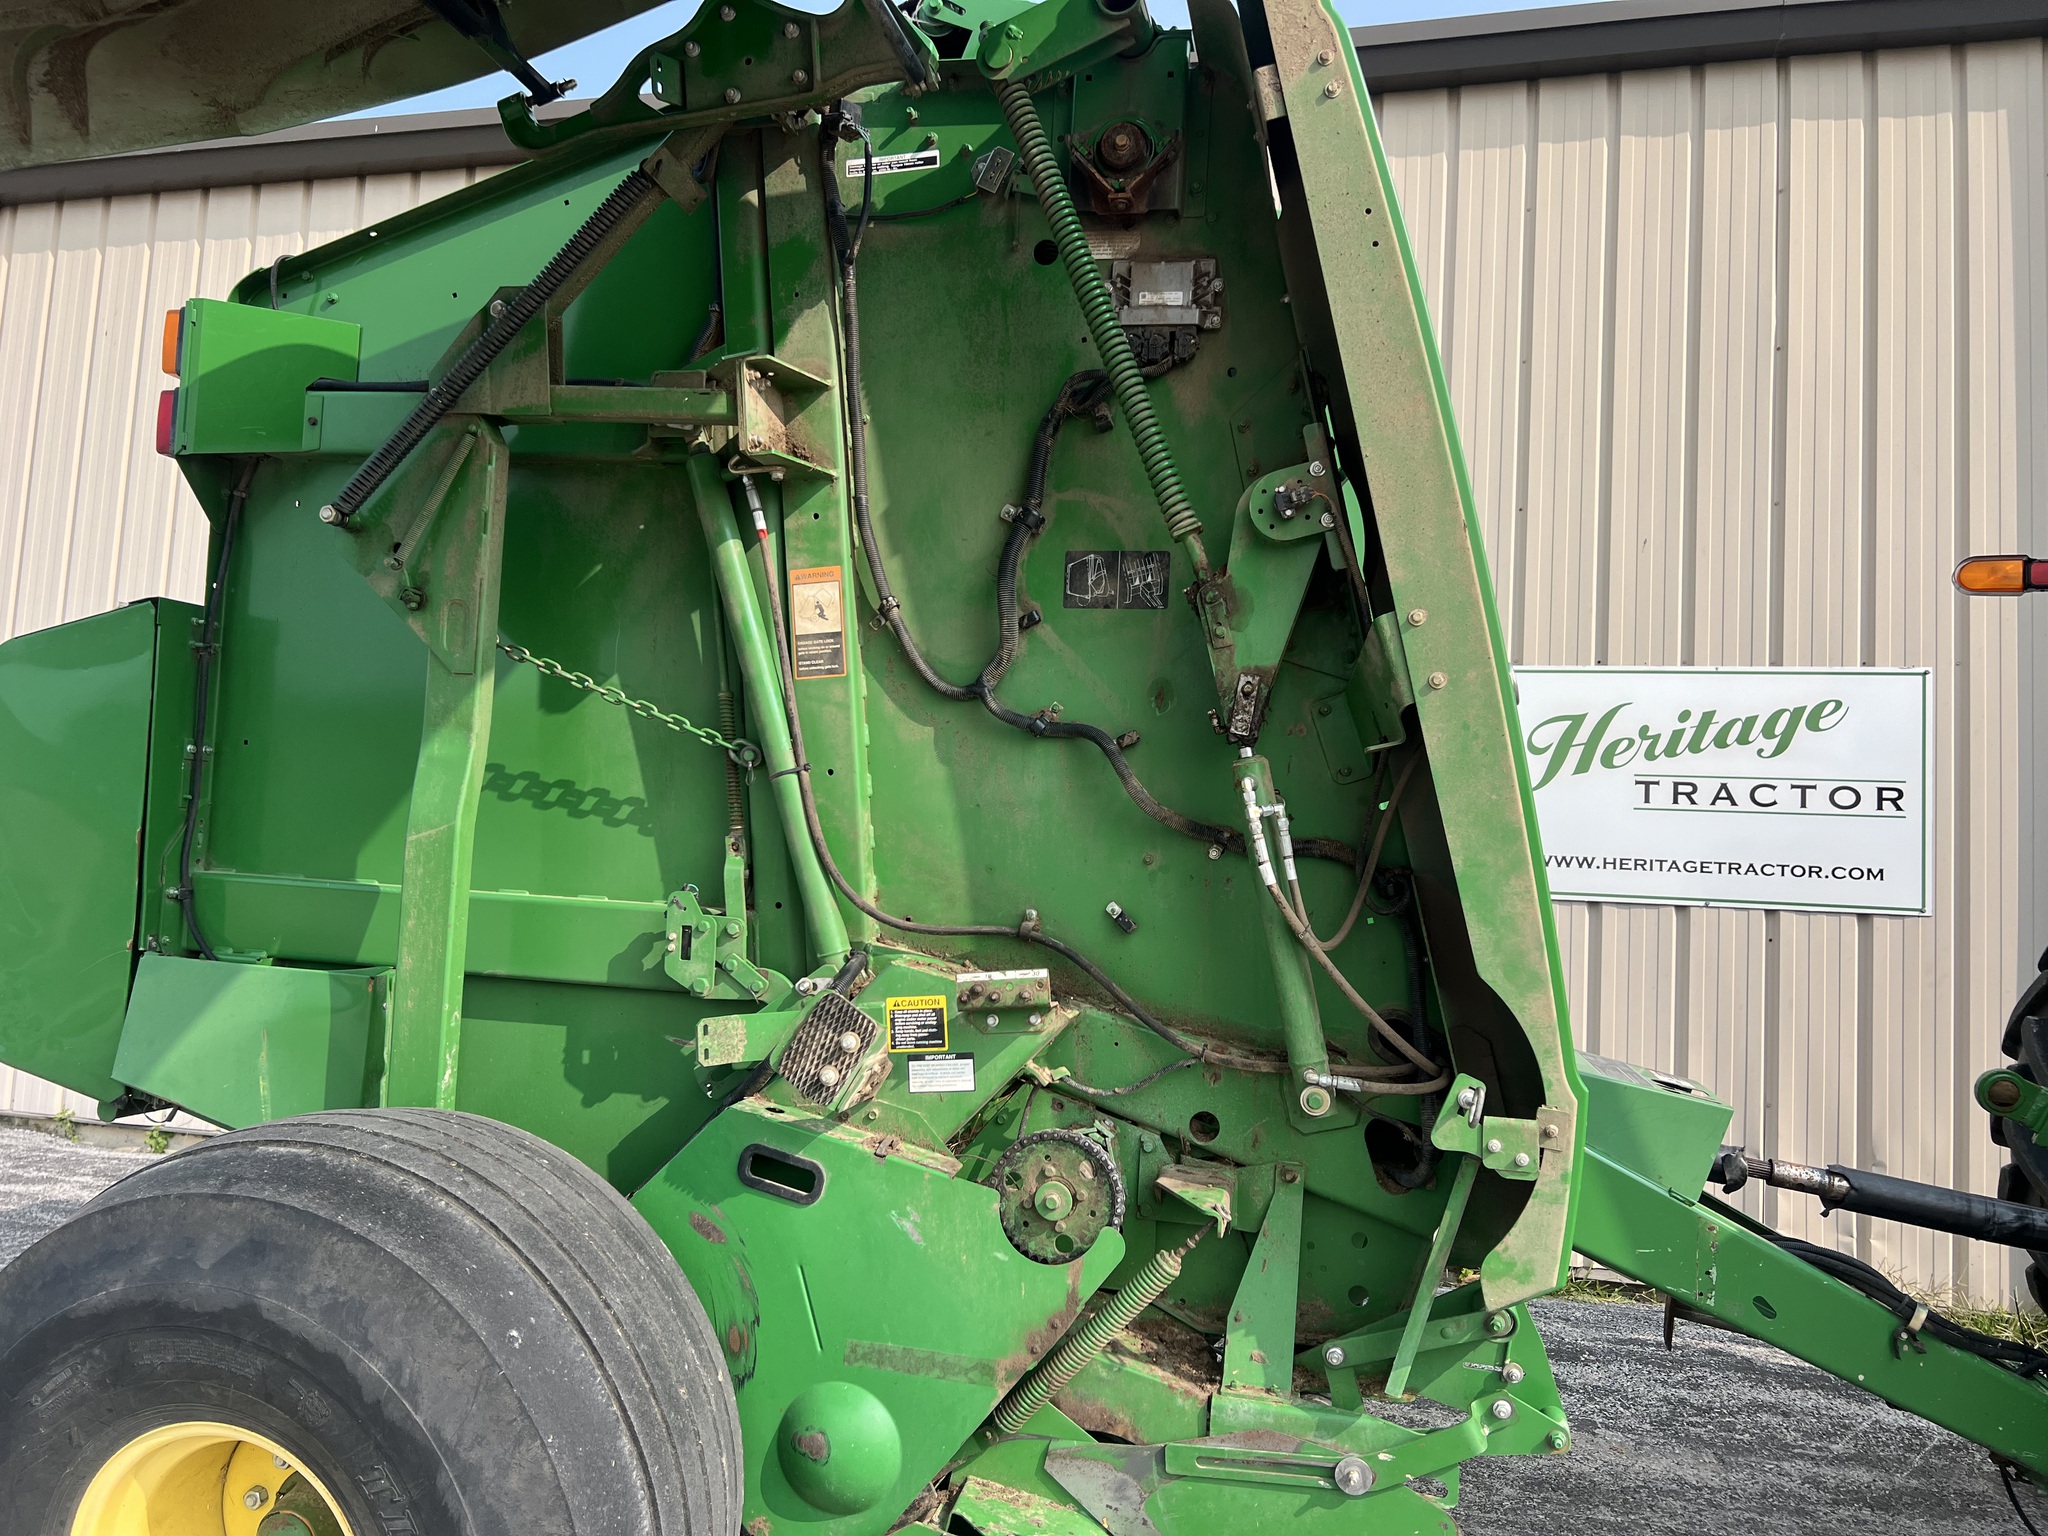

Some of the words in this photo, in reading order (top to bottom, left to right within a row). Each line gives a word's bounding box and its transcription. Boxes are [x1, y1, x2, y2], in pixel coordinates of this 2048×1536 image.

[800, 571, 834, 580] WARNING
[1527, 699, 1849, 791] Heritage
[1634, 779, 1905, 812] TRACTOR
[900, 998, 940, 1007] CAUTION
